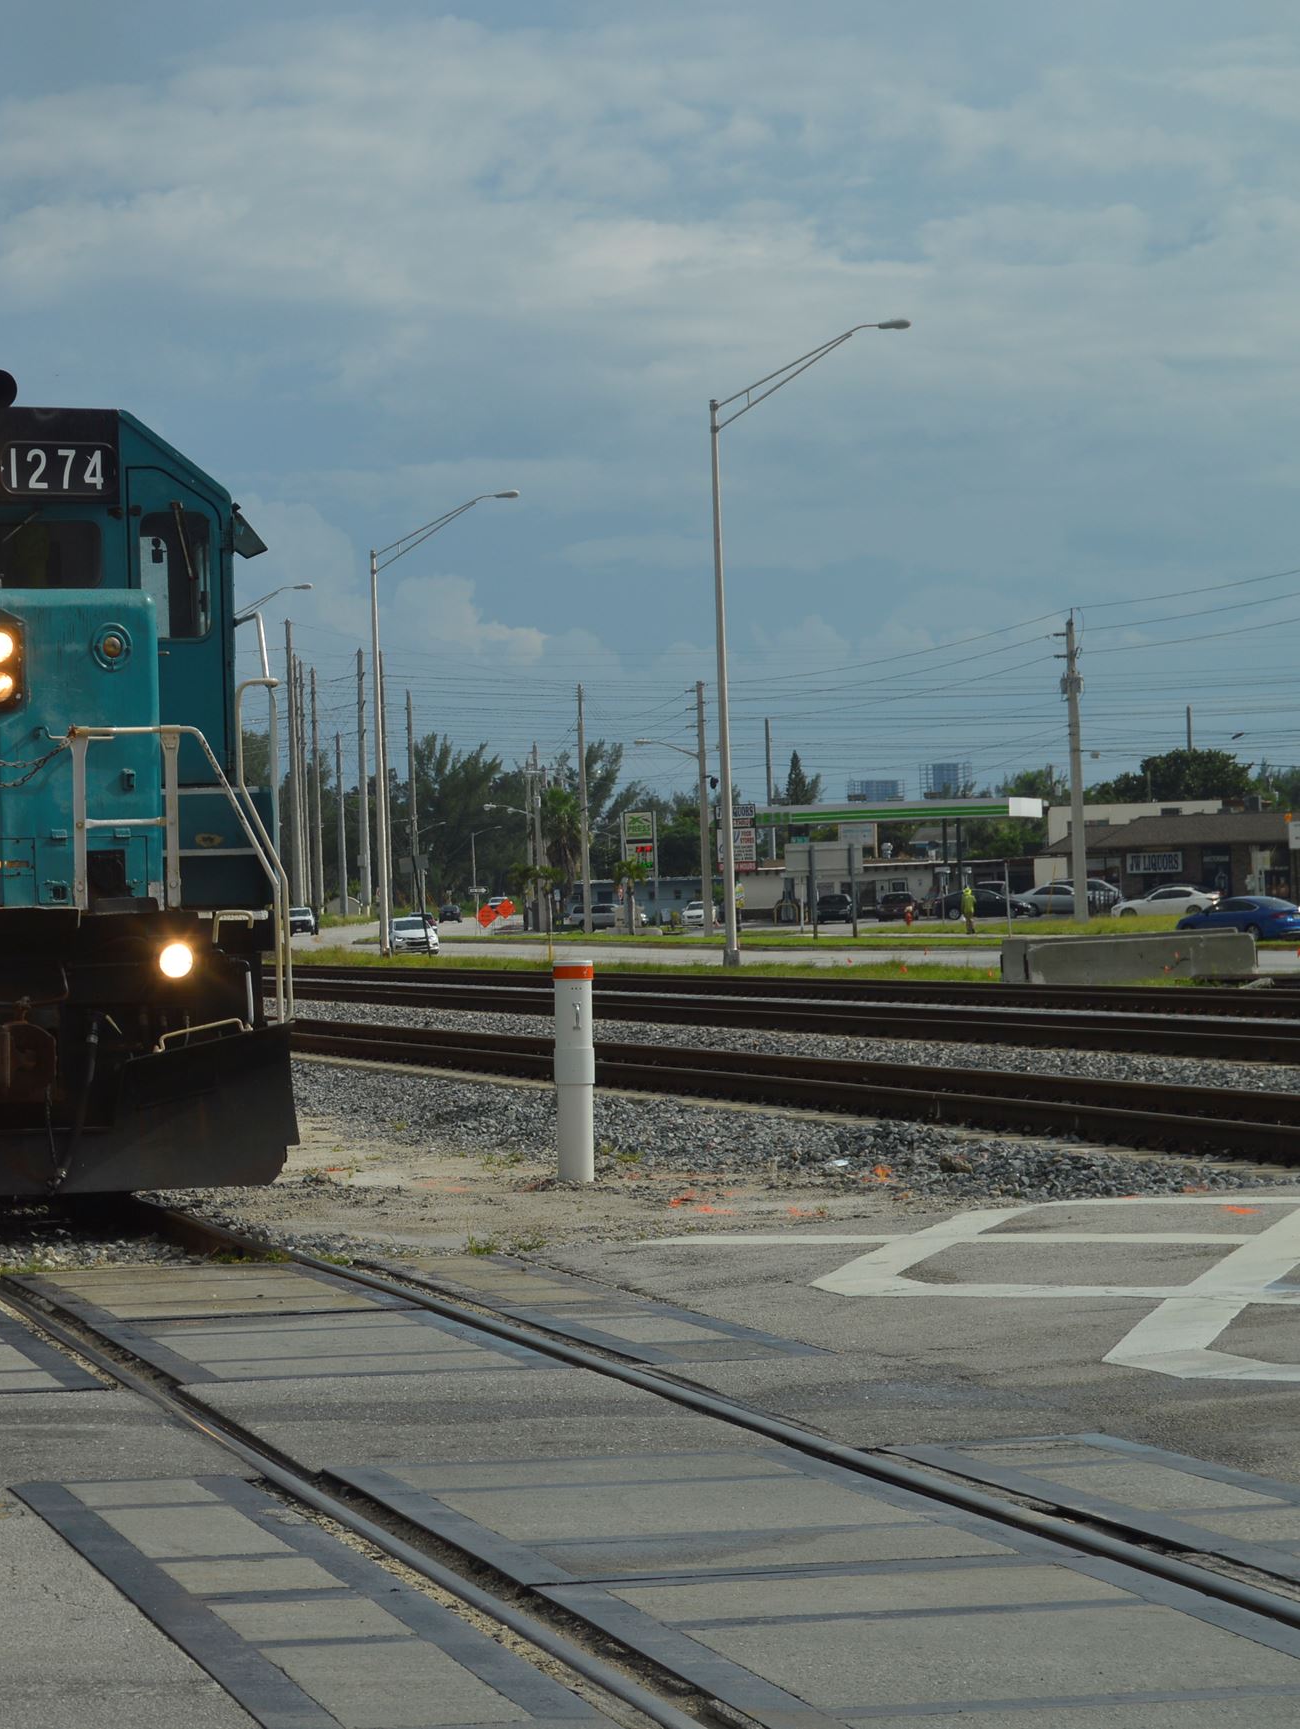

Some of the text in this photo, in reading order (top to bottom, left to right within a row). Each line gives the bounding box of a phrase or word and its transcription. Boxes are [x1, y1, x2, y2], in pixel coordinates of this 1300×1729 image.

[9, 447, 104, 491] 1274
[1129, 853, 1180, 872] JW LIQUORS
